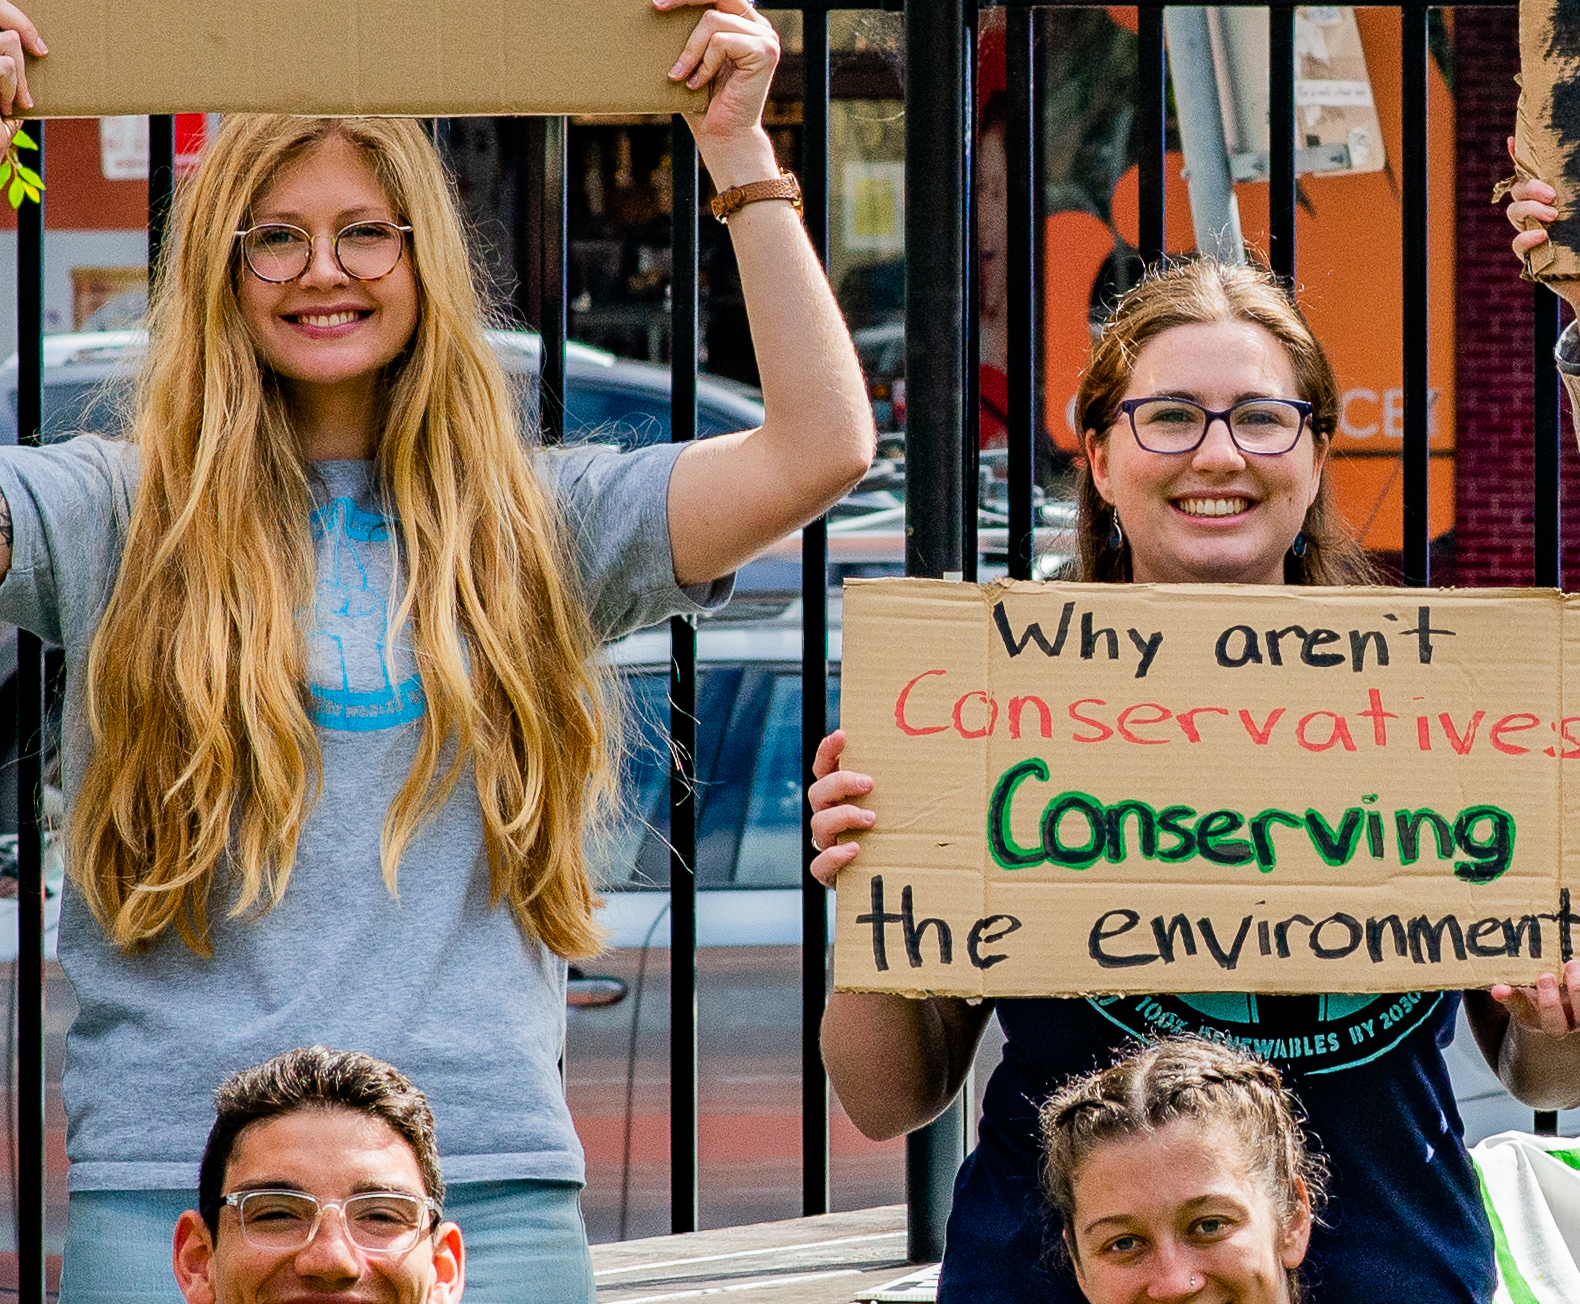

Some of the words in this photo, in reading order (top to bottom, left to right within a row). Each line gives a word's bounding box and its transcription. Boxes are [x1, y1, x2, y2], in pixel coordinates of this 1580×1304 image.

[992, 600, 1164, 678] Why
[1217, 606, 1456, 673] aren't
[987, 757, 1515, 884] Conserving
[856, 875, 1023, 973] the
[1348, 1018, 1376, 1045] BY
